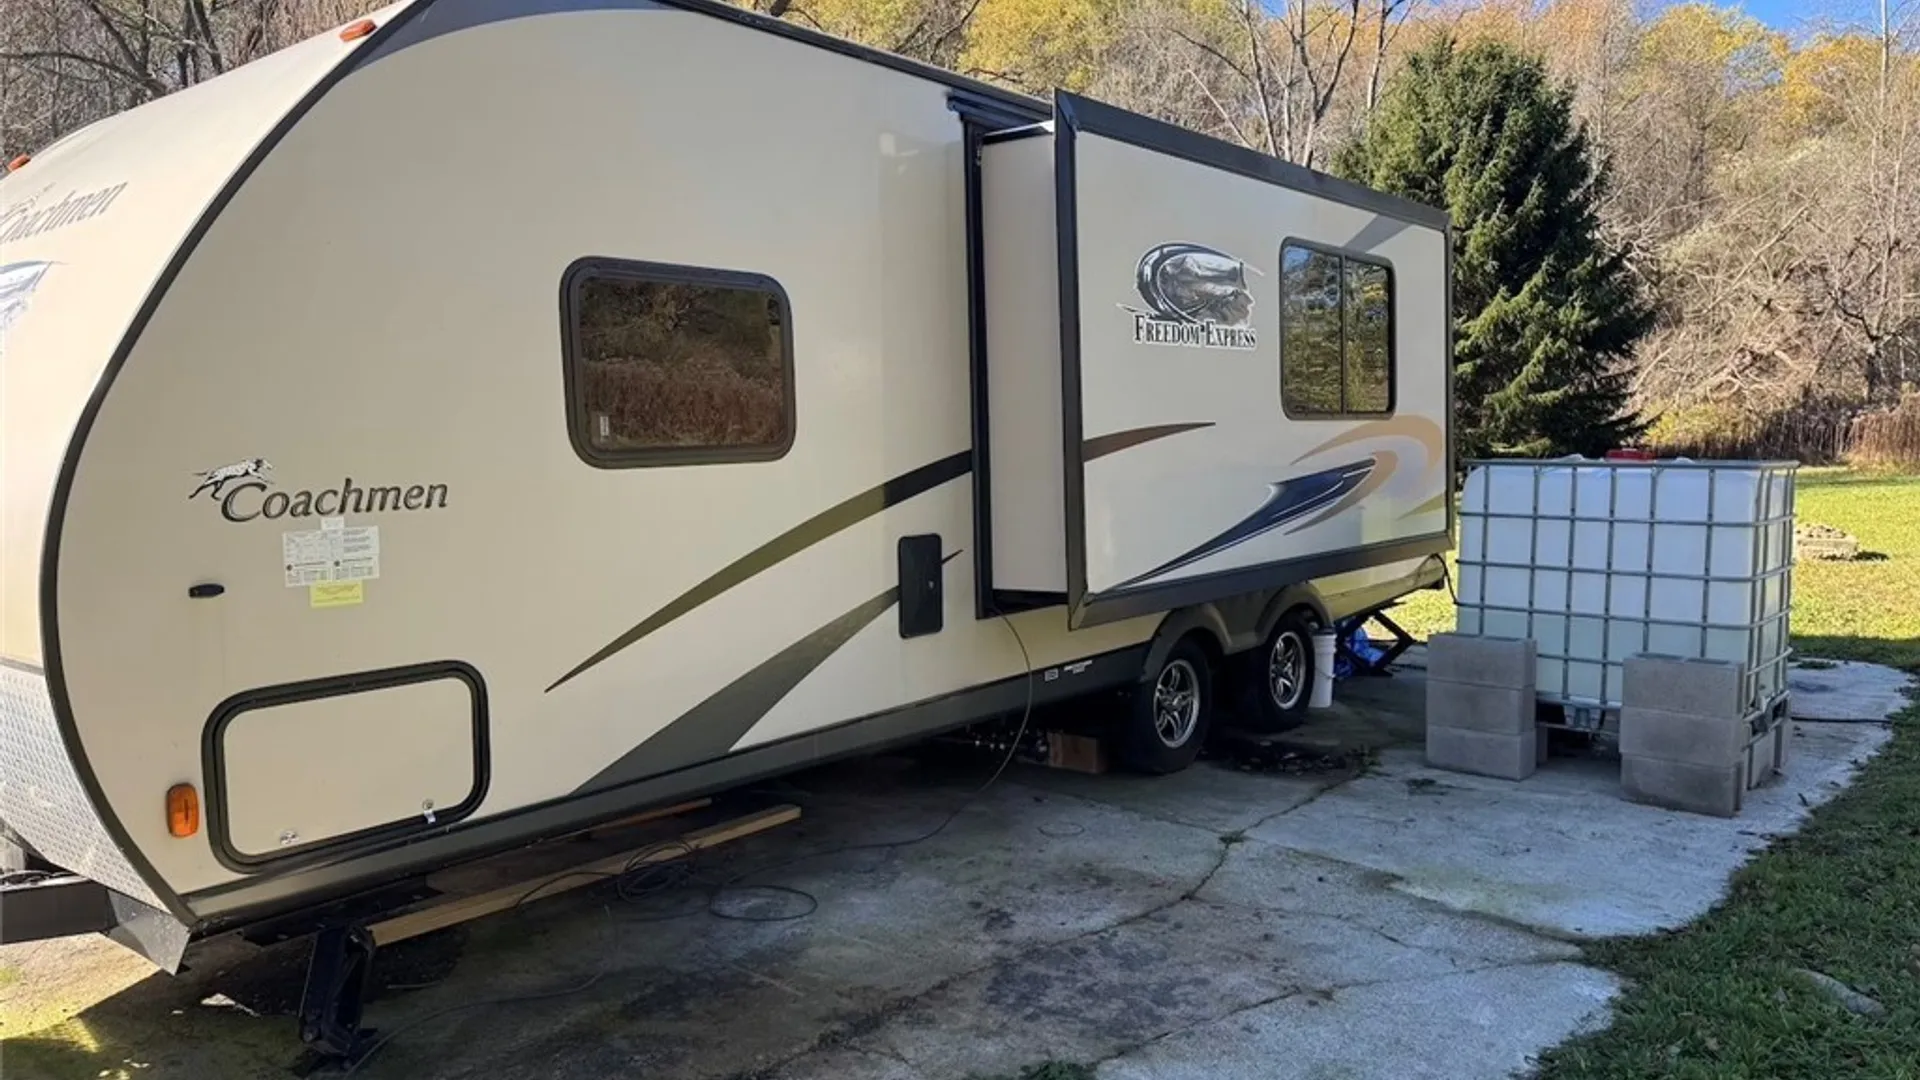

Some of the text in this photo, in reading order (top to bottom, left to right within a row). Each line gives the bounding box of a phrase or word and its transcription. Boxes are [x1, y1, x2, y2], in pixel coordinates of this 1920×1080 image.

[1134, 315, 1256, 348] FREEDOM EXPRESS
[221, 477, 448, 522] Coachmen
